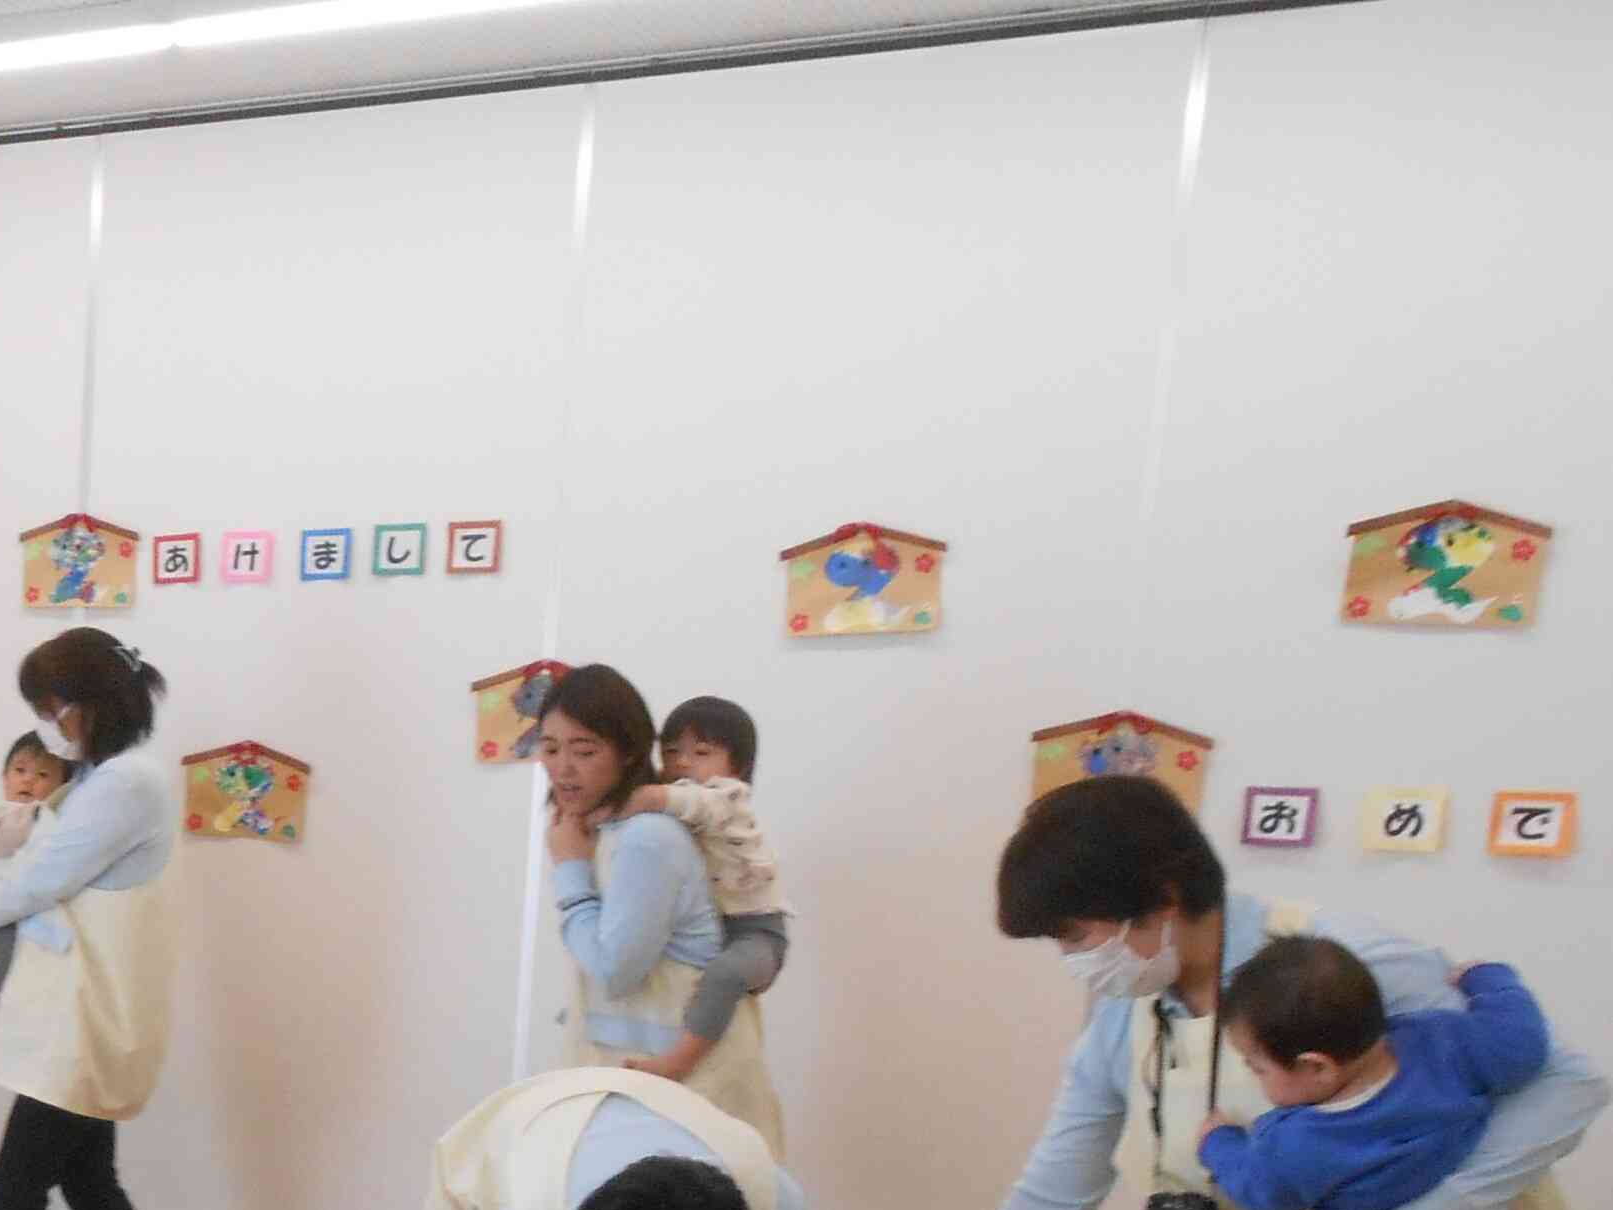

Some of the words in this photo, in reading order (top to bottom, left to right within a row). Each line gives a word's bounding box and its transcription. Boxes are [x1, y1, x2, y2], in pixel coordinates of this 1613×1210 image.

[164, 536, 488, 573] あけまして
[1258, 802, 1552, 839] おめで
